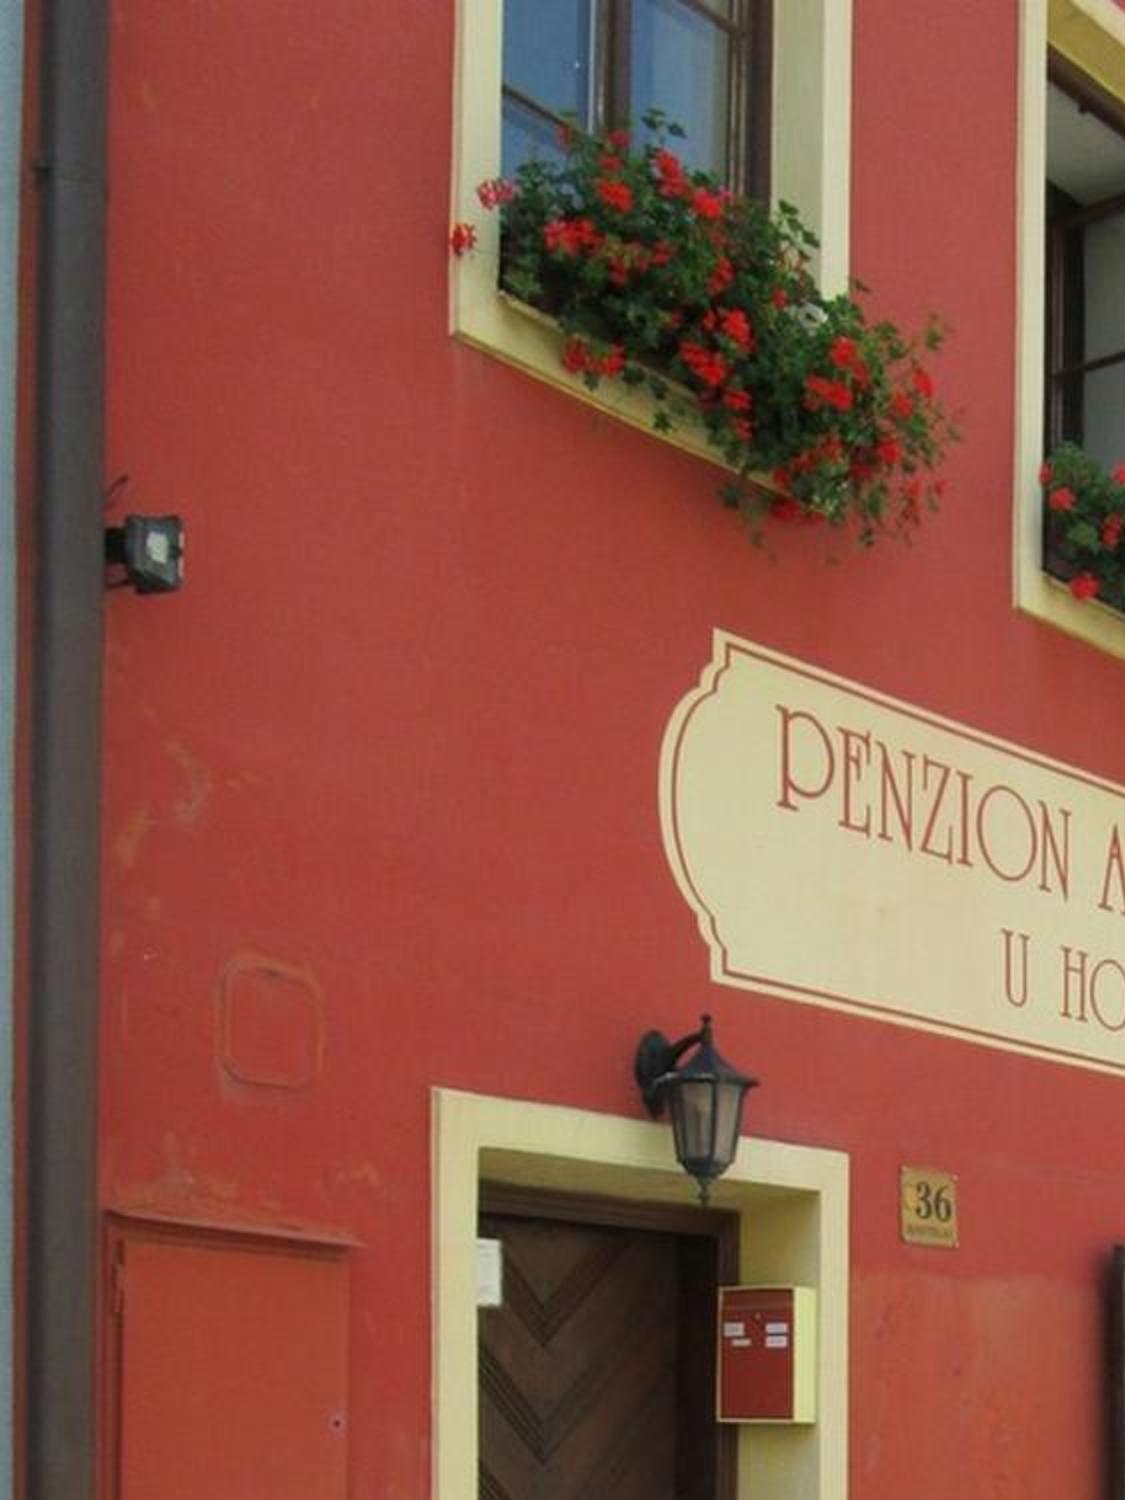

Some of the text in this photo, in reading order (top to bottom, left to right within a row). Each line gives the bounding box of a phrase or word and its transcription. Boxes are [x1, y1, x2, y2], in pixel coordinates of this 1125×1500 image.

[775, 702, 1072, 902] PENZION
[1001, 929, 1030, 1008] U
[915, 1181, 952, 1222] 36
